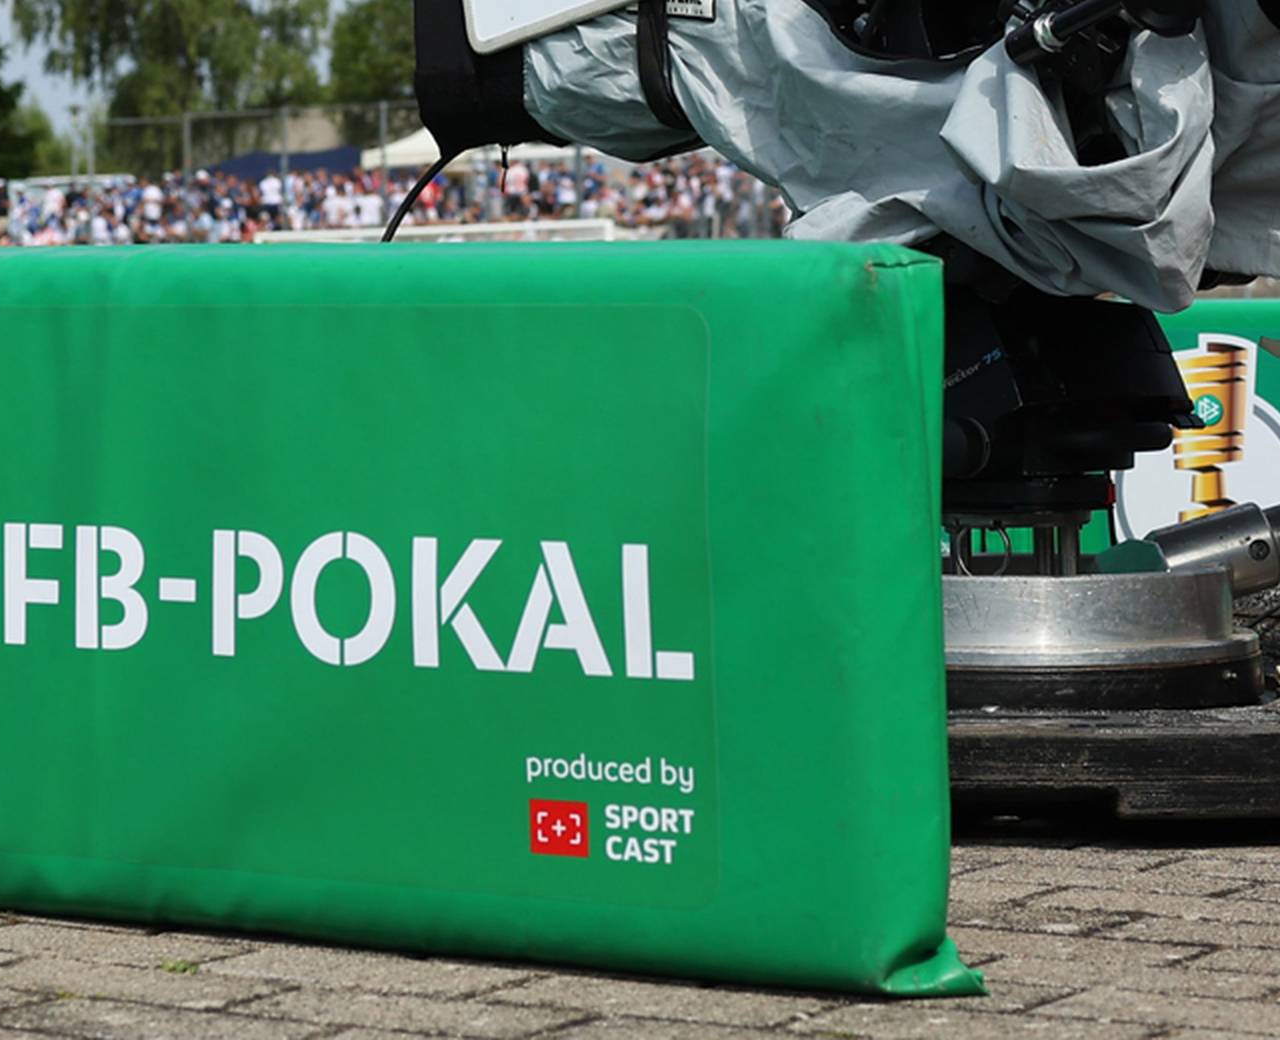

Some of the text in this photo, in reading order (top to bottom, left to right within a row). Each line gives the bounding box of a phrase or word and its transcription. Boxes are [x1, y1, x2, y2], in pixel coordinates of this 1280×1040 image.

[526, 753, 694, 793] produced by
[604, 804, 694, 834] SPORT
[605, 835, 677, 864] CAST
